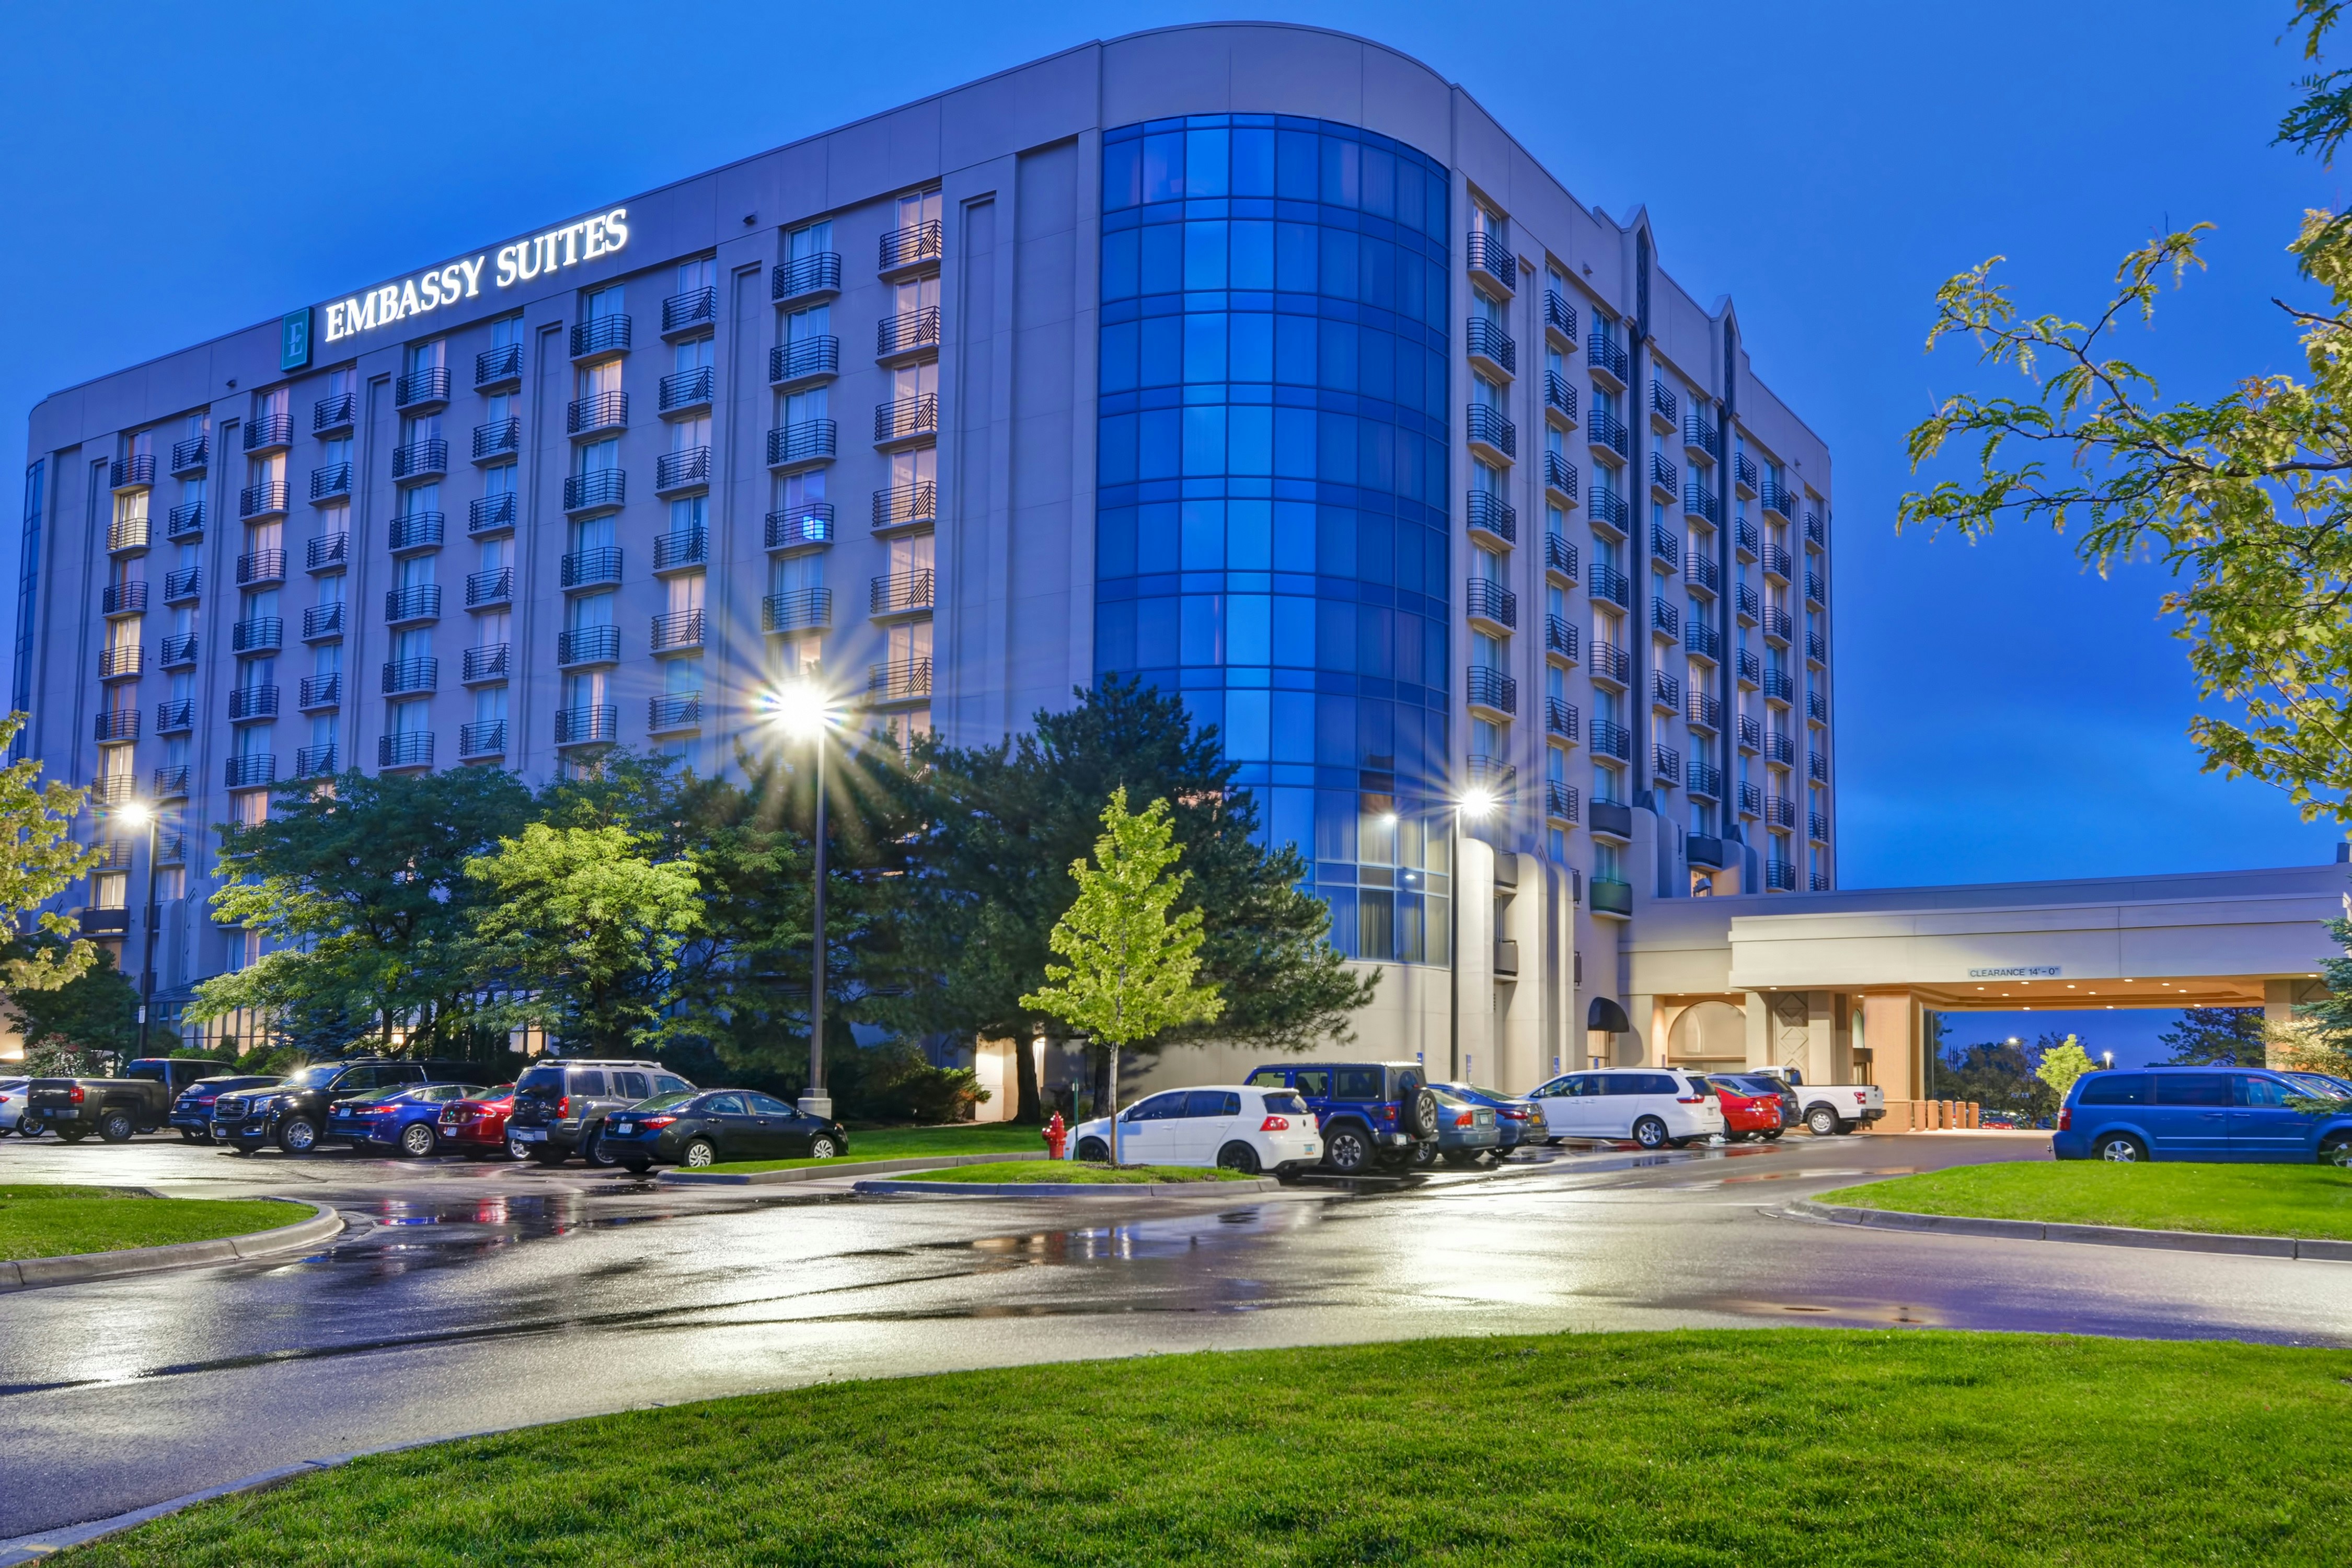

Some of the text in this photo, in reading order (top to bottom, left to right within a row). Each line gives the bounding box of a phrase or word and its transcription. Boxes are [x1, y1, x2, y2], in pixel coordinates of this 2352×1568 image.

[325, 208, 627, 342] EMBASSY SUITES
[1969, 969, 2025, 977] CLEARANCE
